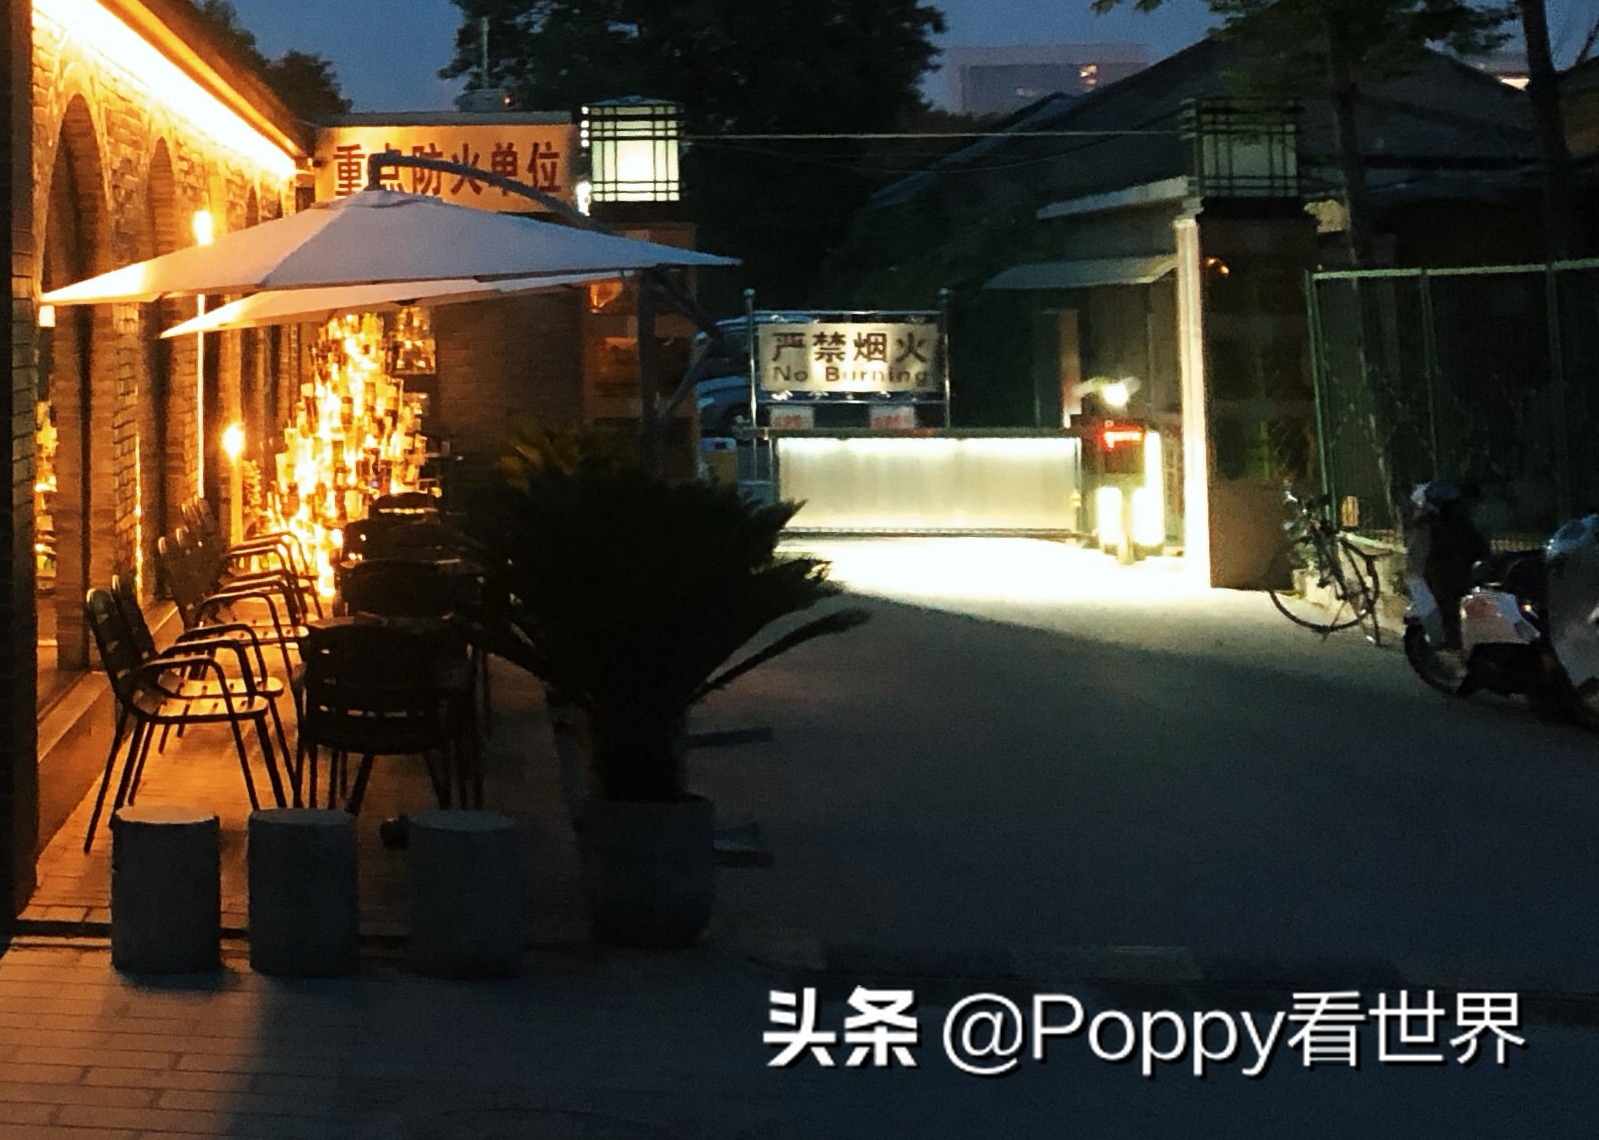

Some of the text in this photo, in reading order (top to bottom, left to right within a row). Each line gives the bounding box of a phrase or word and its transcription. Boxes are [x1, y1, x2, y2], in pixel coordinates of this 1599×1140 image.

[771, 331, 927, 363] 严禁烟火
[773, 365, 930, 387] No Burning
